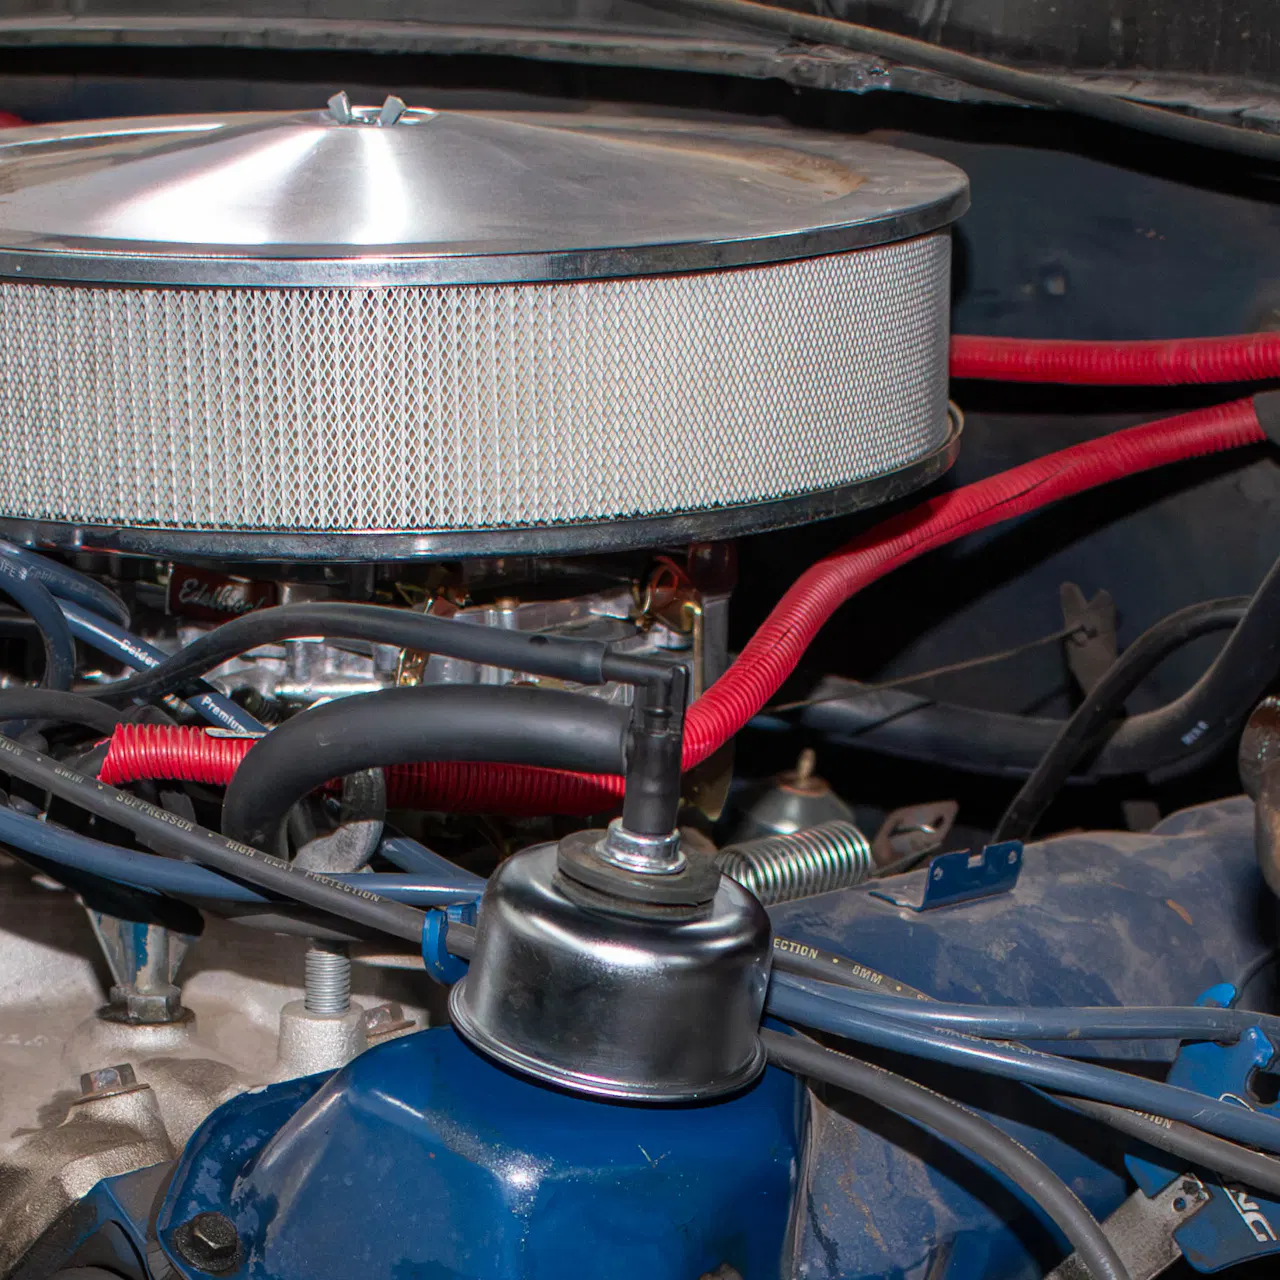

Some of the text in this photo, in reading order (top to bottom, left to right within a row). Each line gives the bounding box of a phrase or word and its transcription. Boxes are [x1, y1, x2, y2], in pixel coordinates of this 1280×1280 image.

[116, 791, 195, 832] SUPPRESSOR
[225, 839, 256, 858] HIGH
[304, 871, 382, 903] PROTECTION
[772, 937, 883, 985] ECTION 8MM
